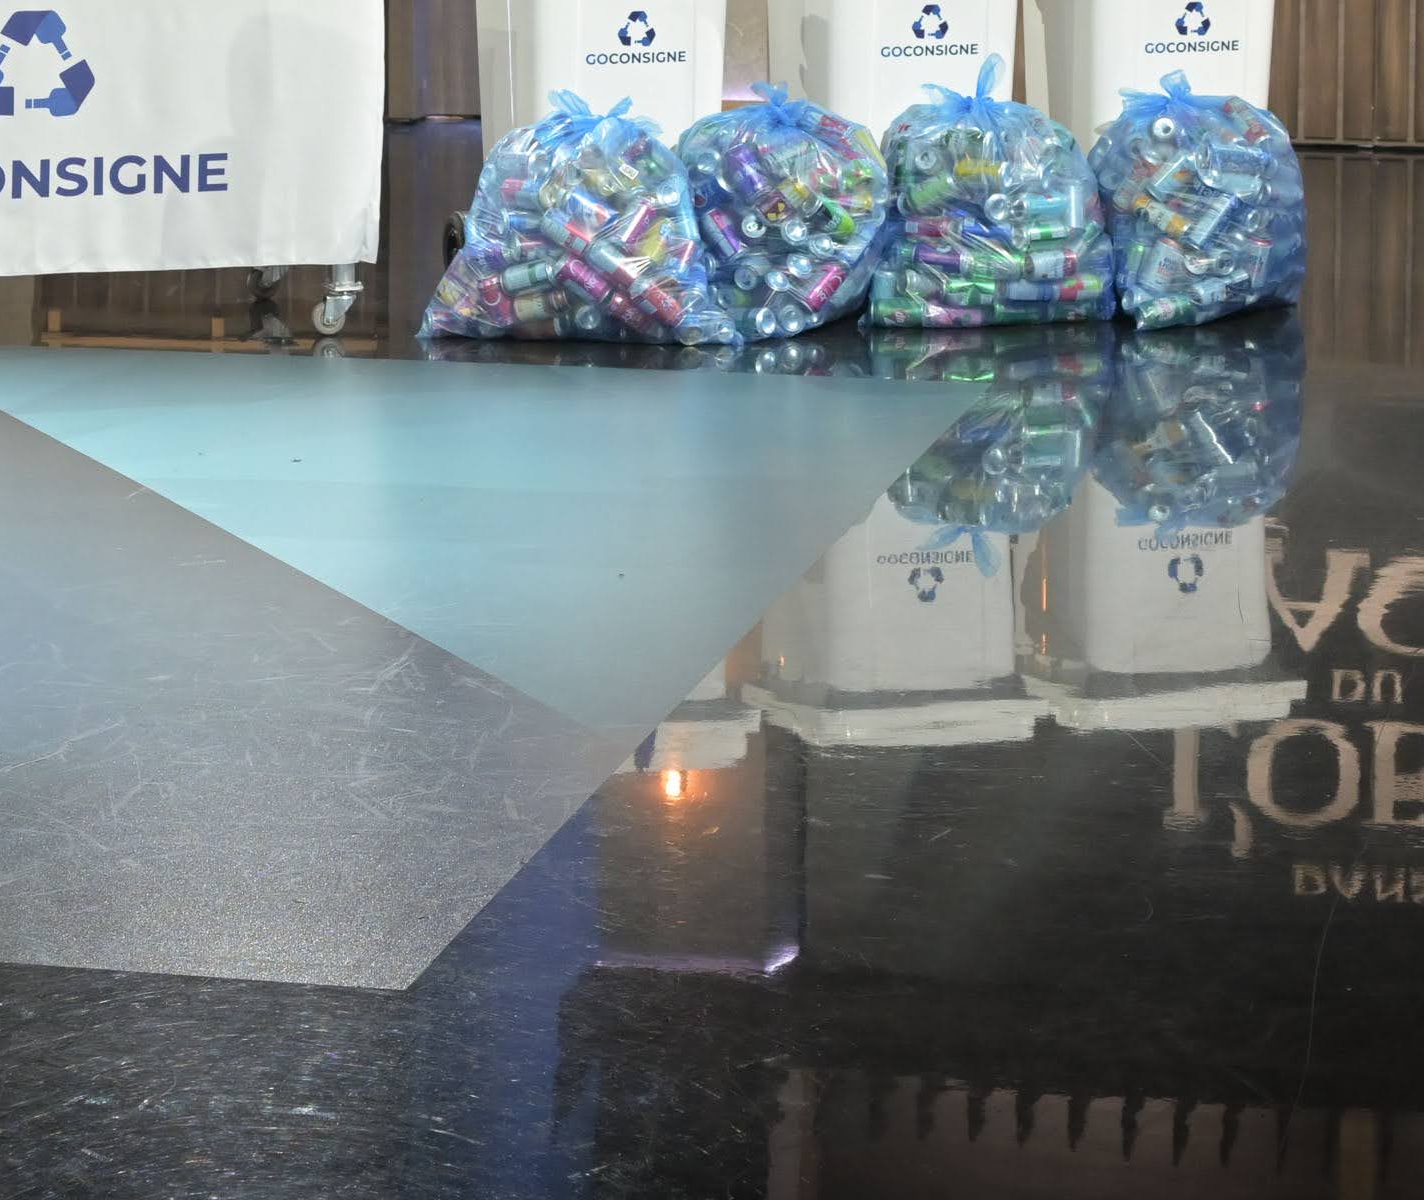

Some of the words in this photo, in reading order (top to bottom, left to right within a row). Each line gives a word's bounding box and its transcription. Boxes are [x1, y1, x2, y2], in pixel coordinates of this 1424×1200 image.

[880, 43, 979, 58] GOCONSIGNE
[1144, 40, 1239, 55] GOCONSIGNE
[585, 50, 687, 66] GOCONSIGNE
